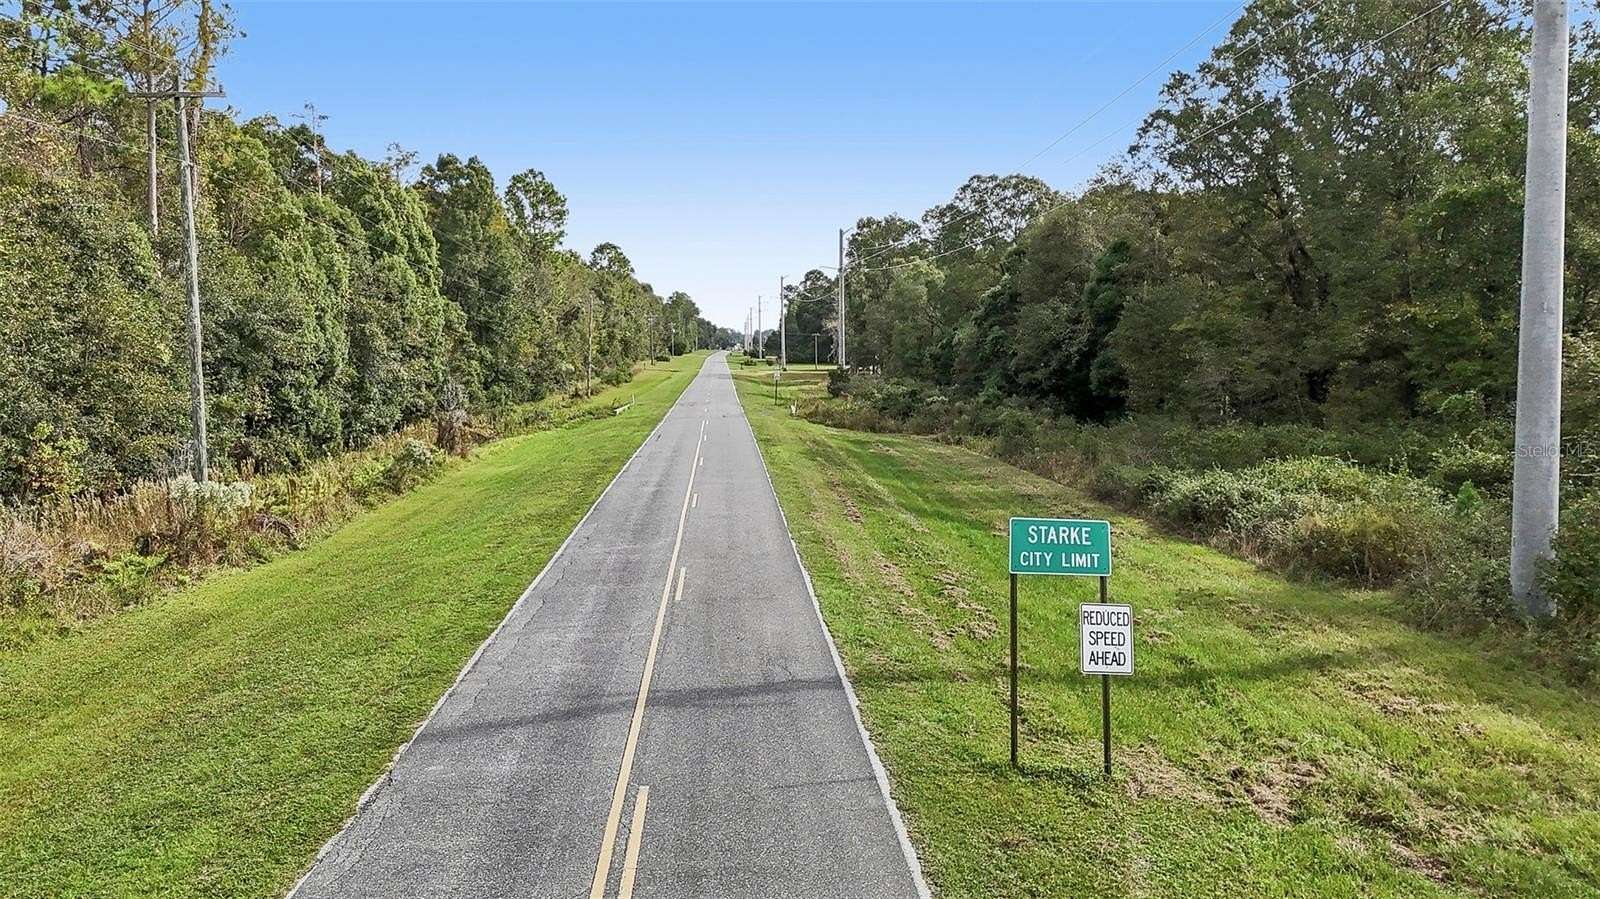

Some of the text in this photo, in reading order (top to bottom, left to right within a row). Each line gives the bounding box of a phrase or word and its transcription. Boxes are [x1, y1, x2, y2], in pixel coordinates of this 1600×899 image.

[1028, 525, 1092, 545] STARKE
[1020, 551, 1100, 568] CITY LIMIT
[1083, 610, 1130, 627] REDUCED
[1088, 631, 1126, 647] SPEED
[1088, 651, 1126, 666] AHEAD
